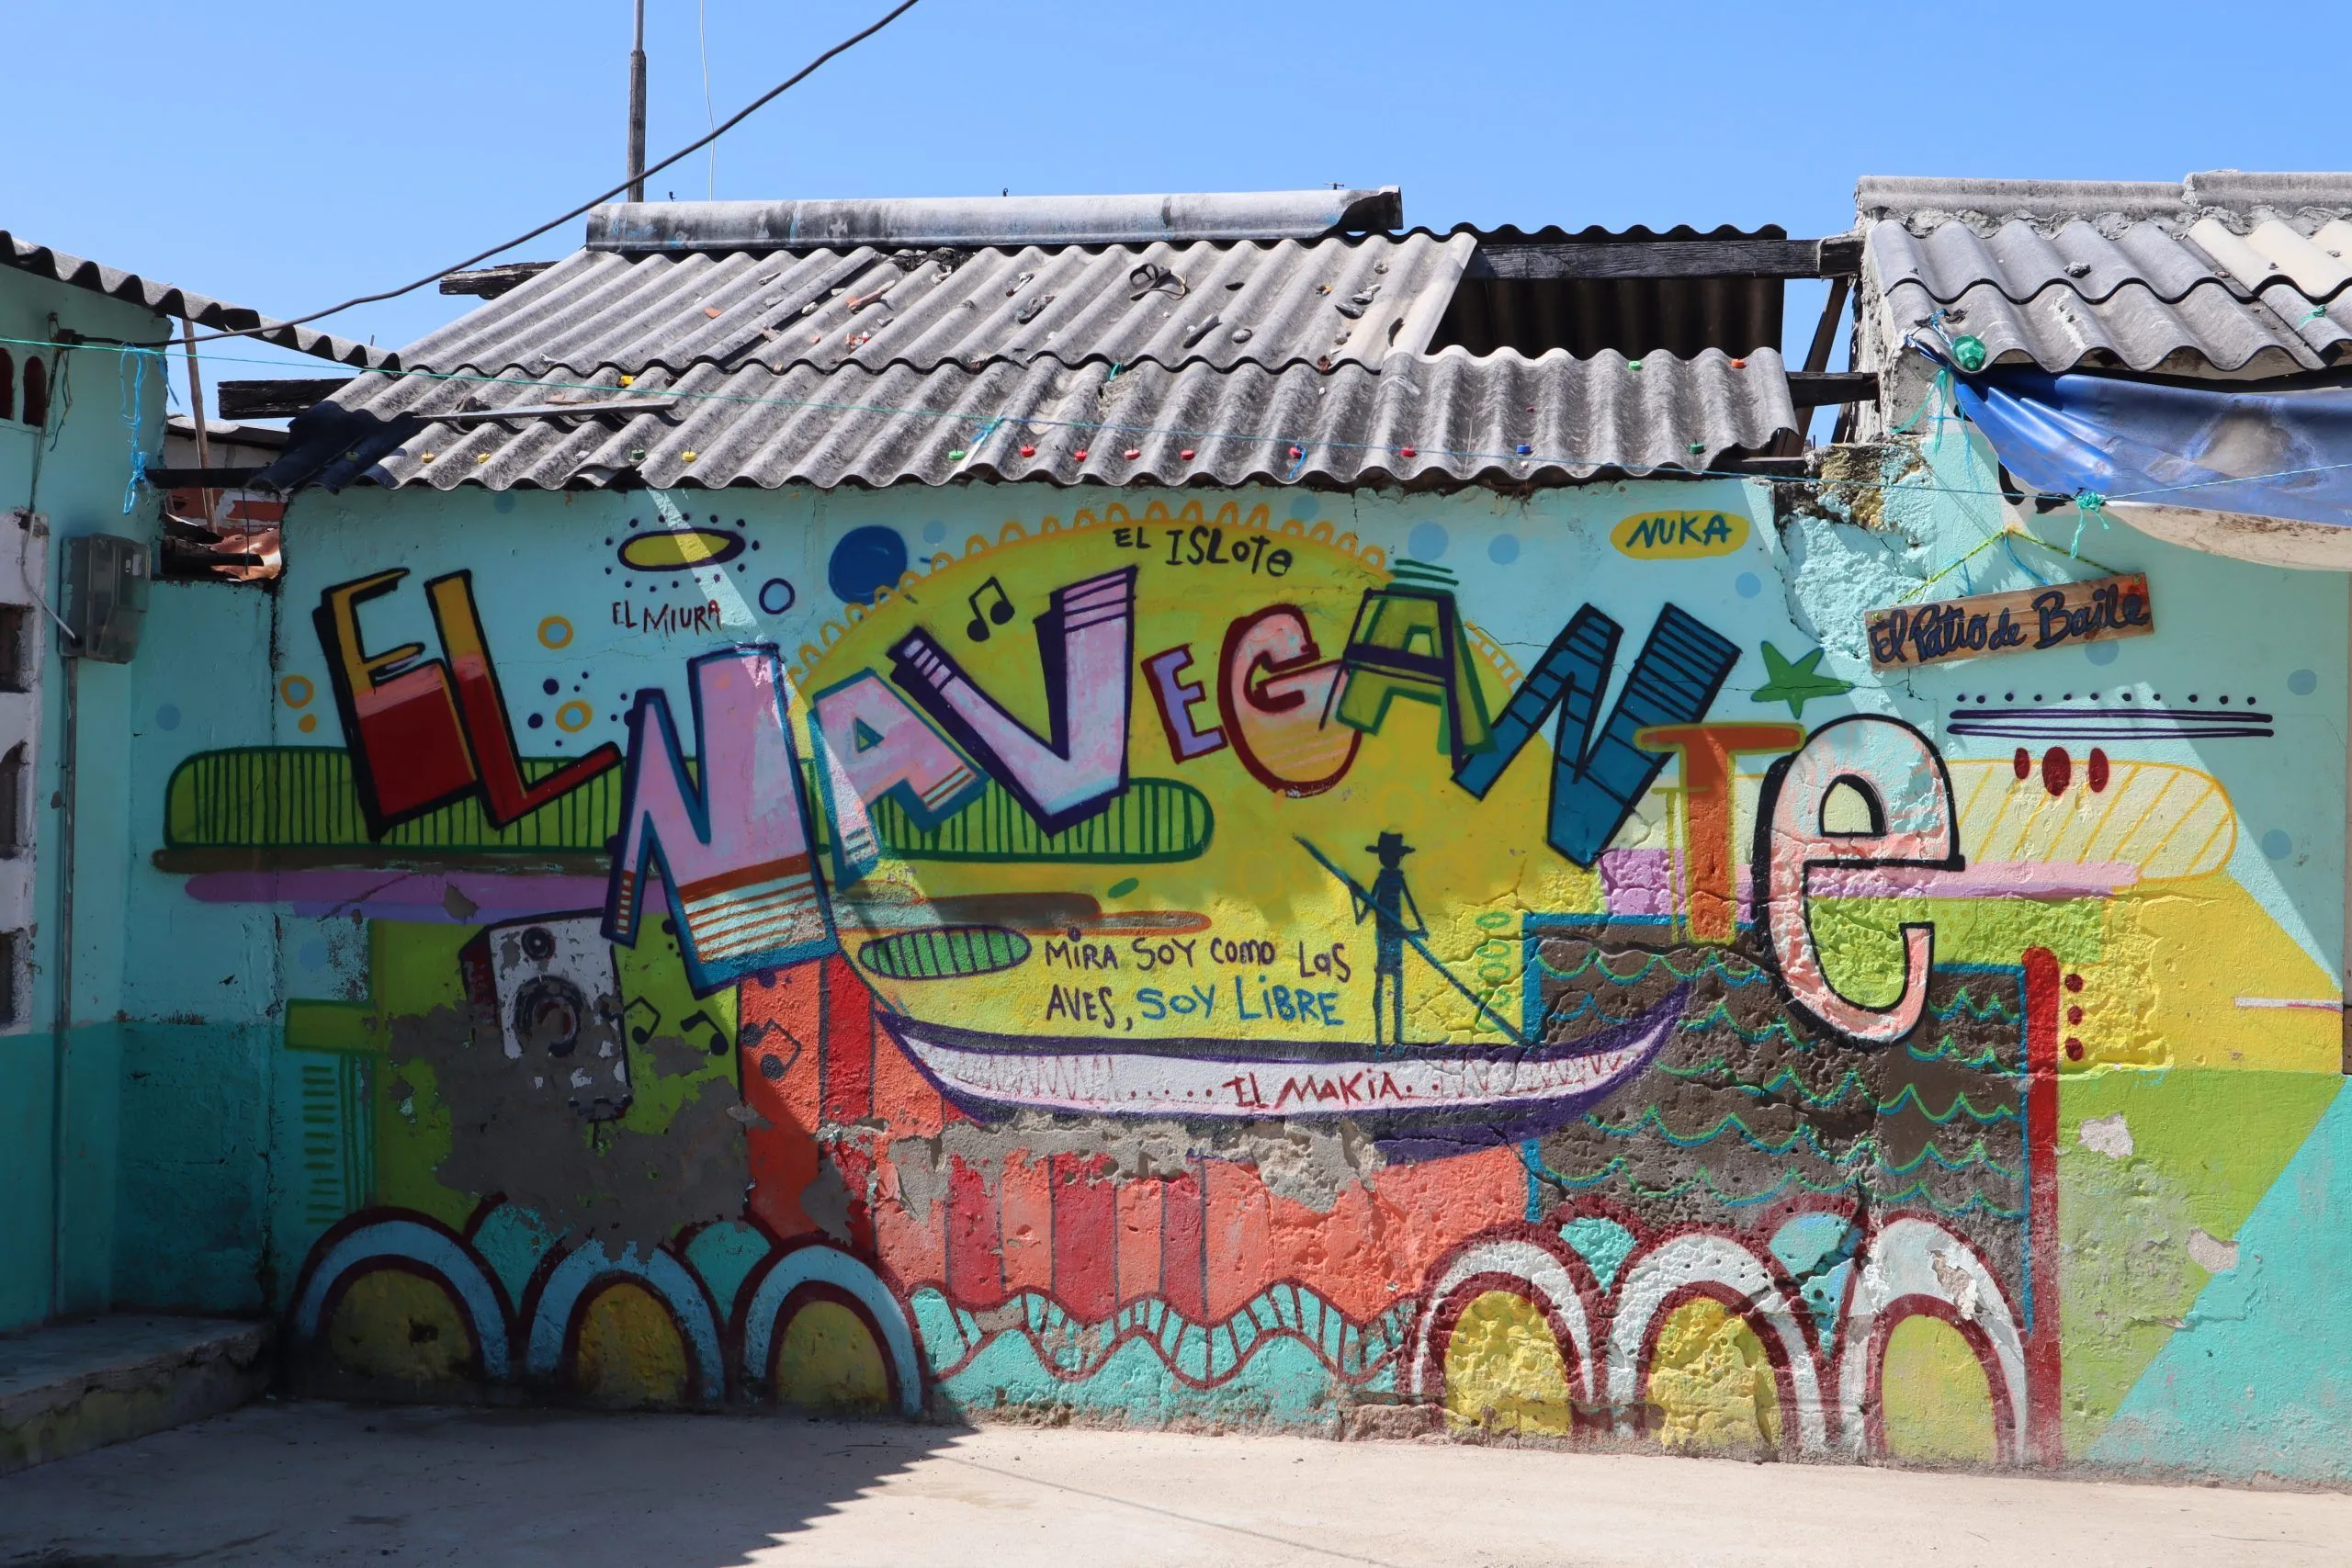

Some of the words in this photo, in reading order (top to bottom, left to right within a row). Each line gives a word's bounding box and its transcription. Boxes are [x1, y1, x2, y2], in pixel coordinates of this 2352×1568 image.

[1112, 526, 1151, 549] EL
[1626, 514, 1733, 548] NUKA
[612, 600, 638, 629] EL
[643, 599, 722, 637] MIURA
[1868, 608, 1909, 664] El
[1908, 604, 1990, 662] Patio
[1987, 607, 2027, 651] de
[2031, 583, 2151, 649] Baile
[312, 567, 623, 841] EL
[1046, 984, 1133, 1032] AVES,
